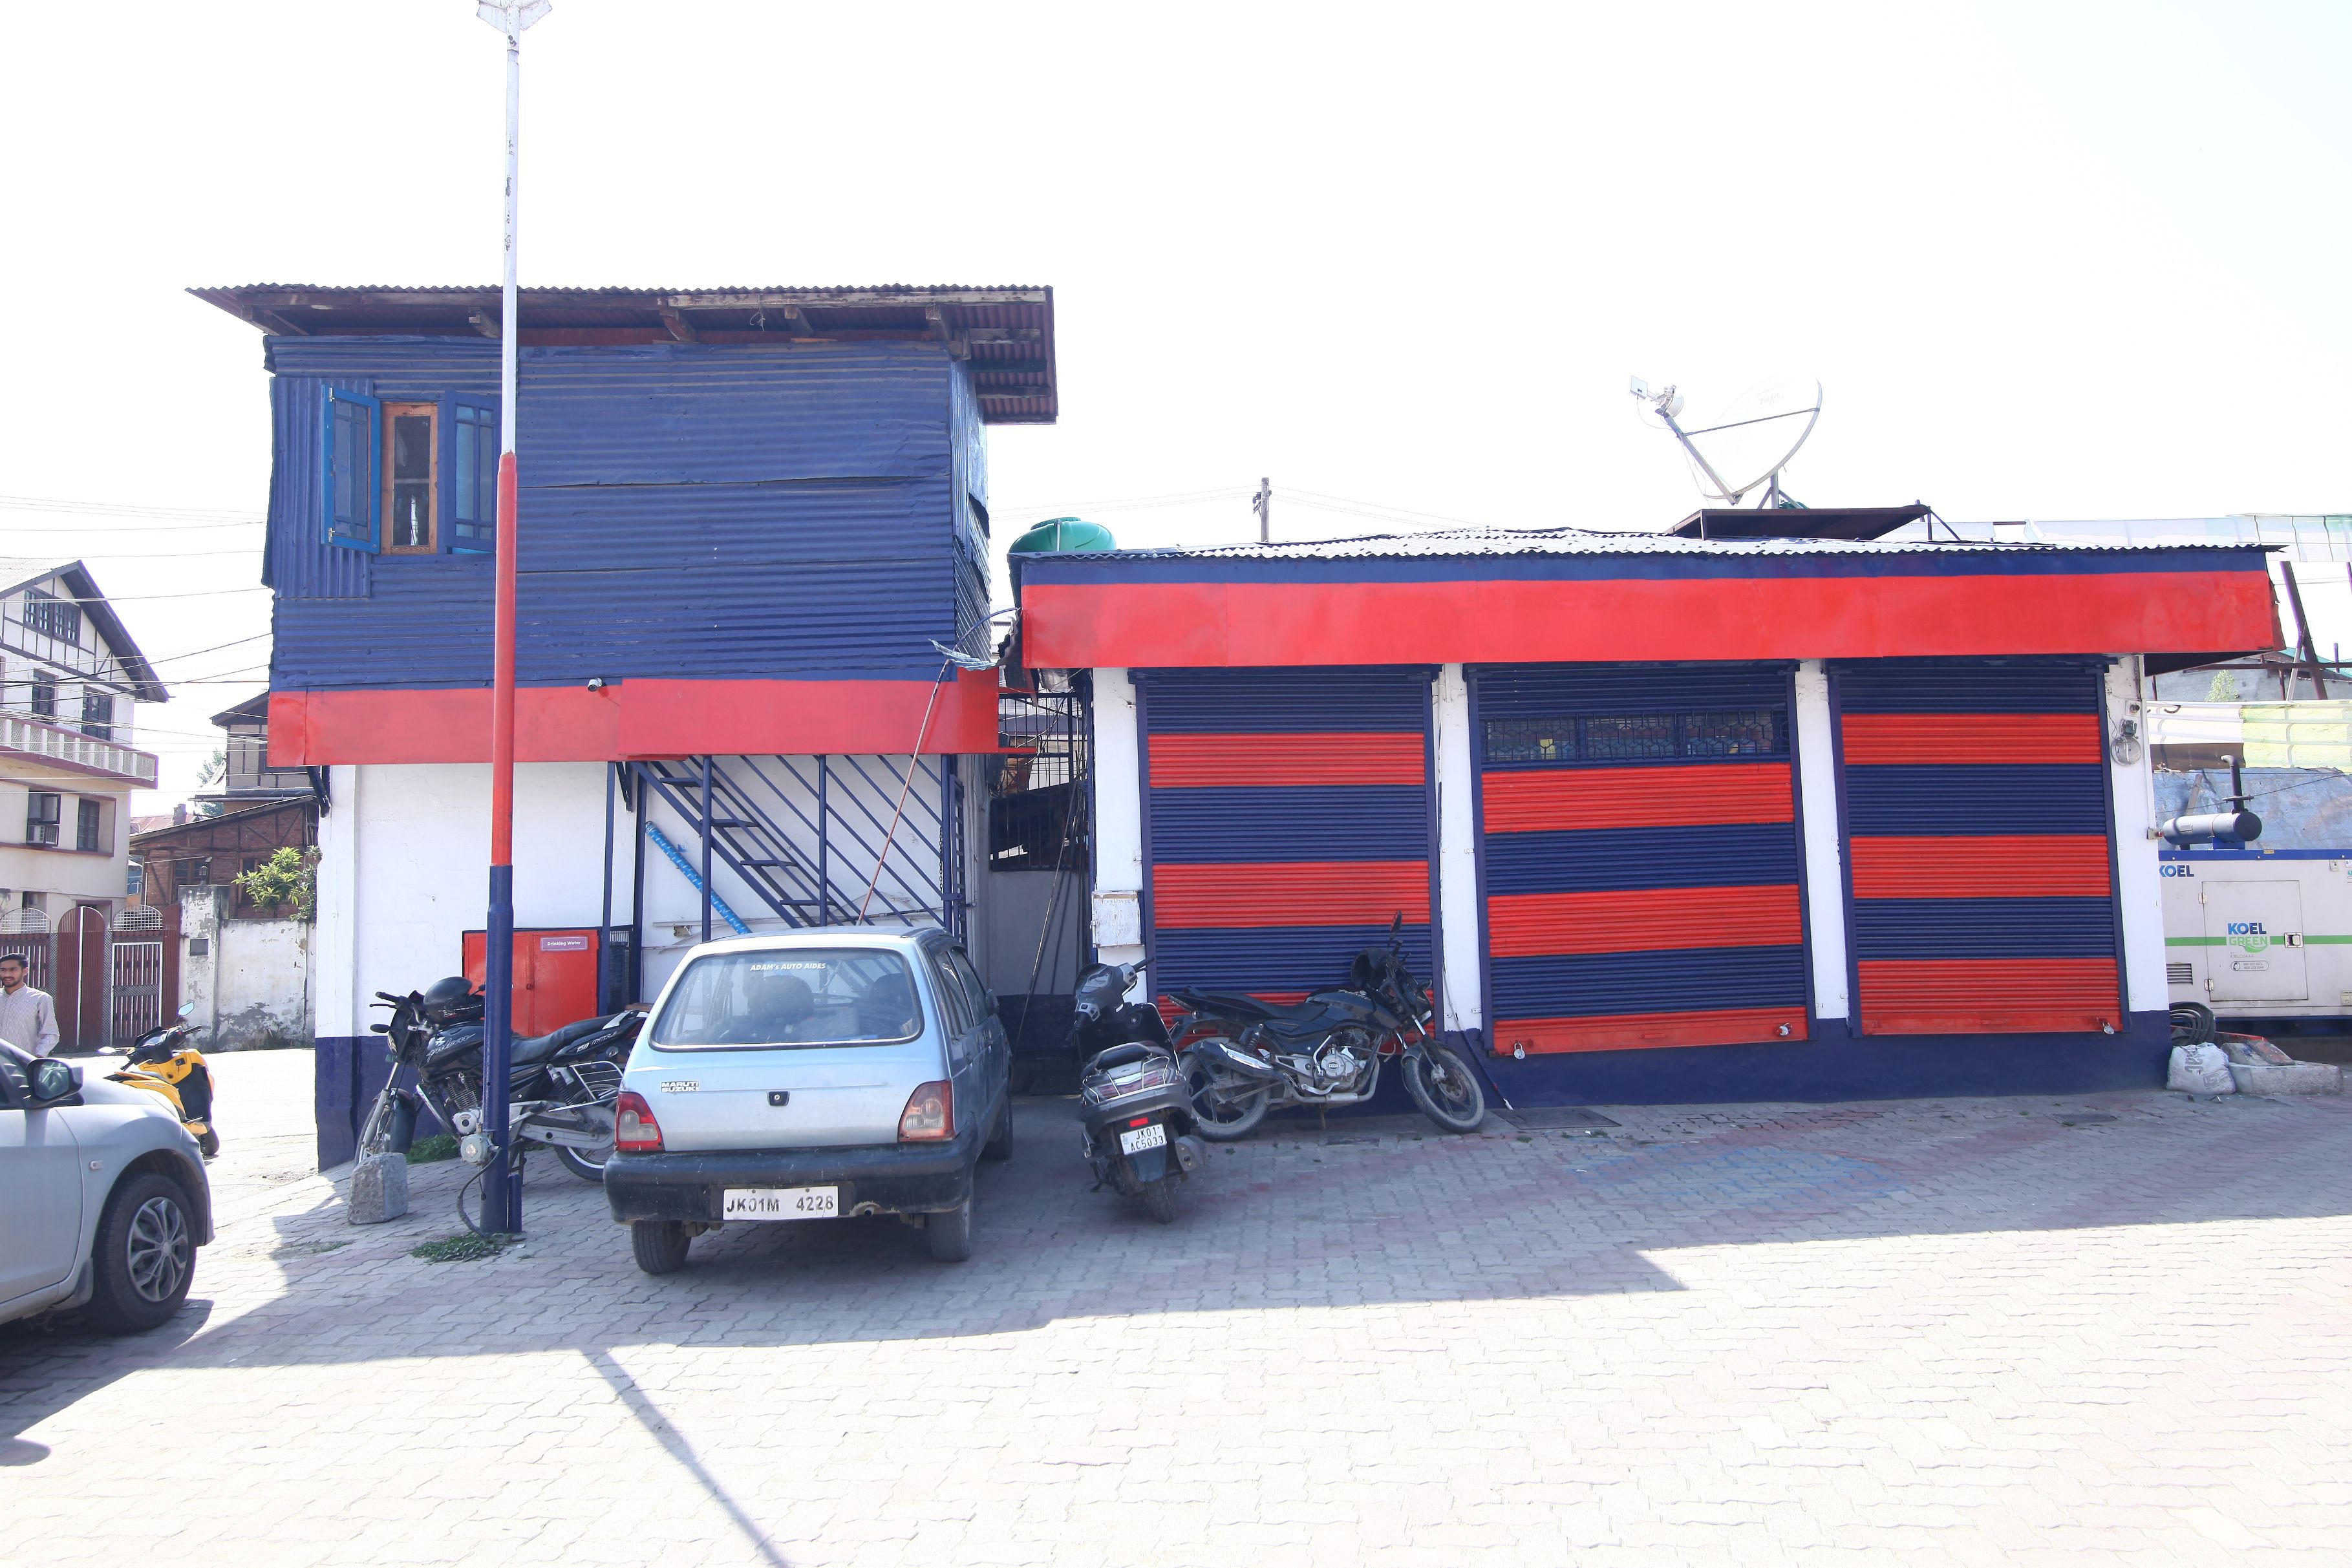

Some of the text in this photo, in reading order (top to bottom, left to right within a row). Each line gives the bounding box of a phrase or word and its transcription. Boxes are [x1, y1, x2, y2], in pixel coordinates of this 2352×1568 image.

[2227, 922, 2267, 935] KOEL
[2229, 936, 2267, 946] GREEN
[1136, 1127, 1157, 1139] JK01
[1131, 1136, 1164, 1151] AC5033
[726, 1196, 833, 1213] JK01M 4228
